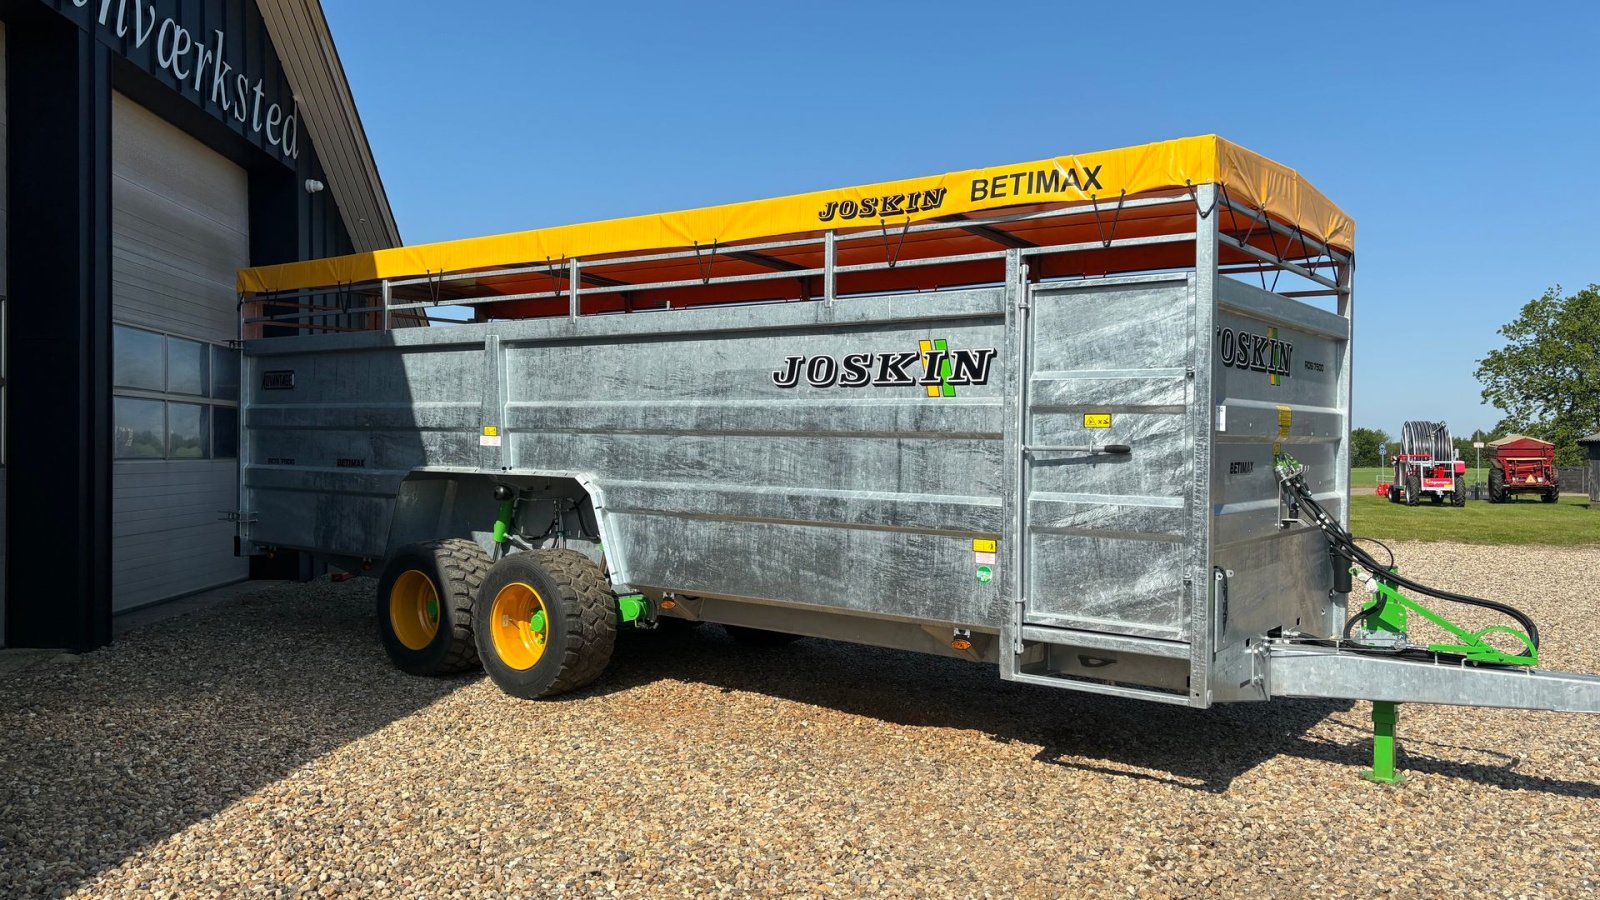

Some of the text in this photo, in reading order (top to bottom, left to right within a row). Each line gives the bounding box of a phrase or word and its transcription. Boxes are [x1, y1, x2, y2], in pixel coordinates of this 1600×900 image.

[73, 0, 300, 160] nværksted
[818, 165, 1103, 221] JOSKIN BETIMAX
[772, 348, 997, 388] JOSKIN
[1216, 325, 1293, 378] OSKIN
[336, 458, 366, 468] BETIMAX
[1230, 461, 1255, 474] BETIMAX
